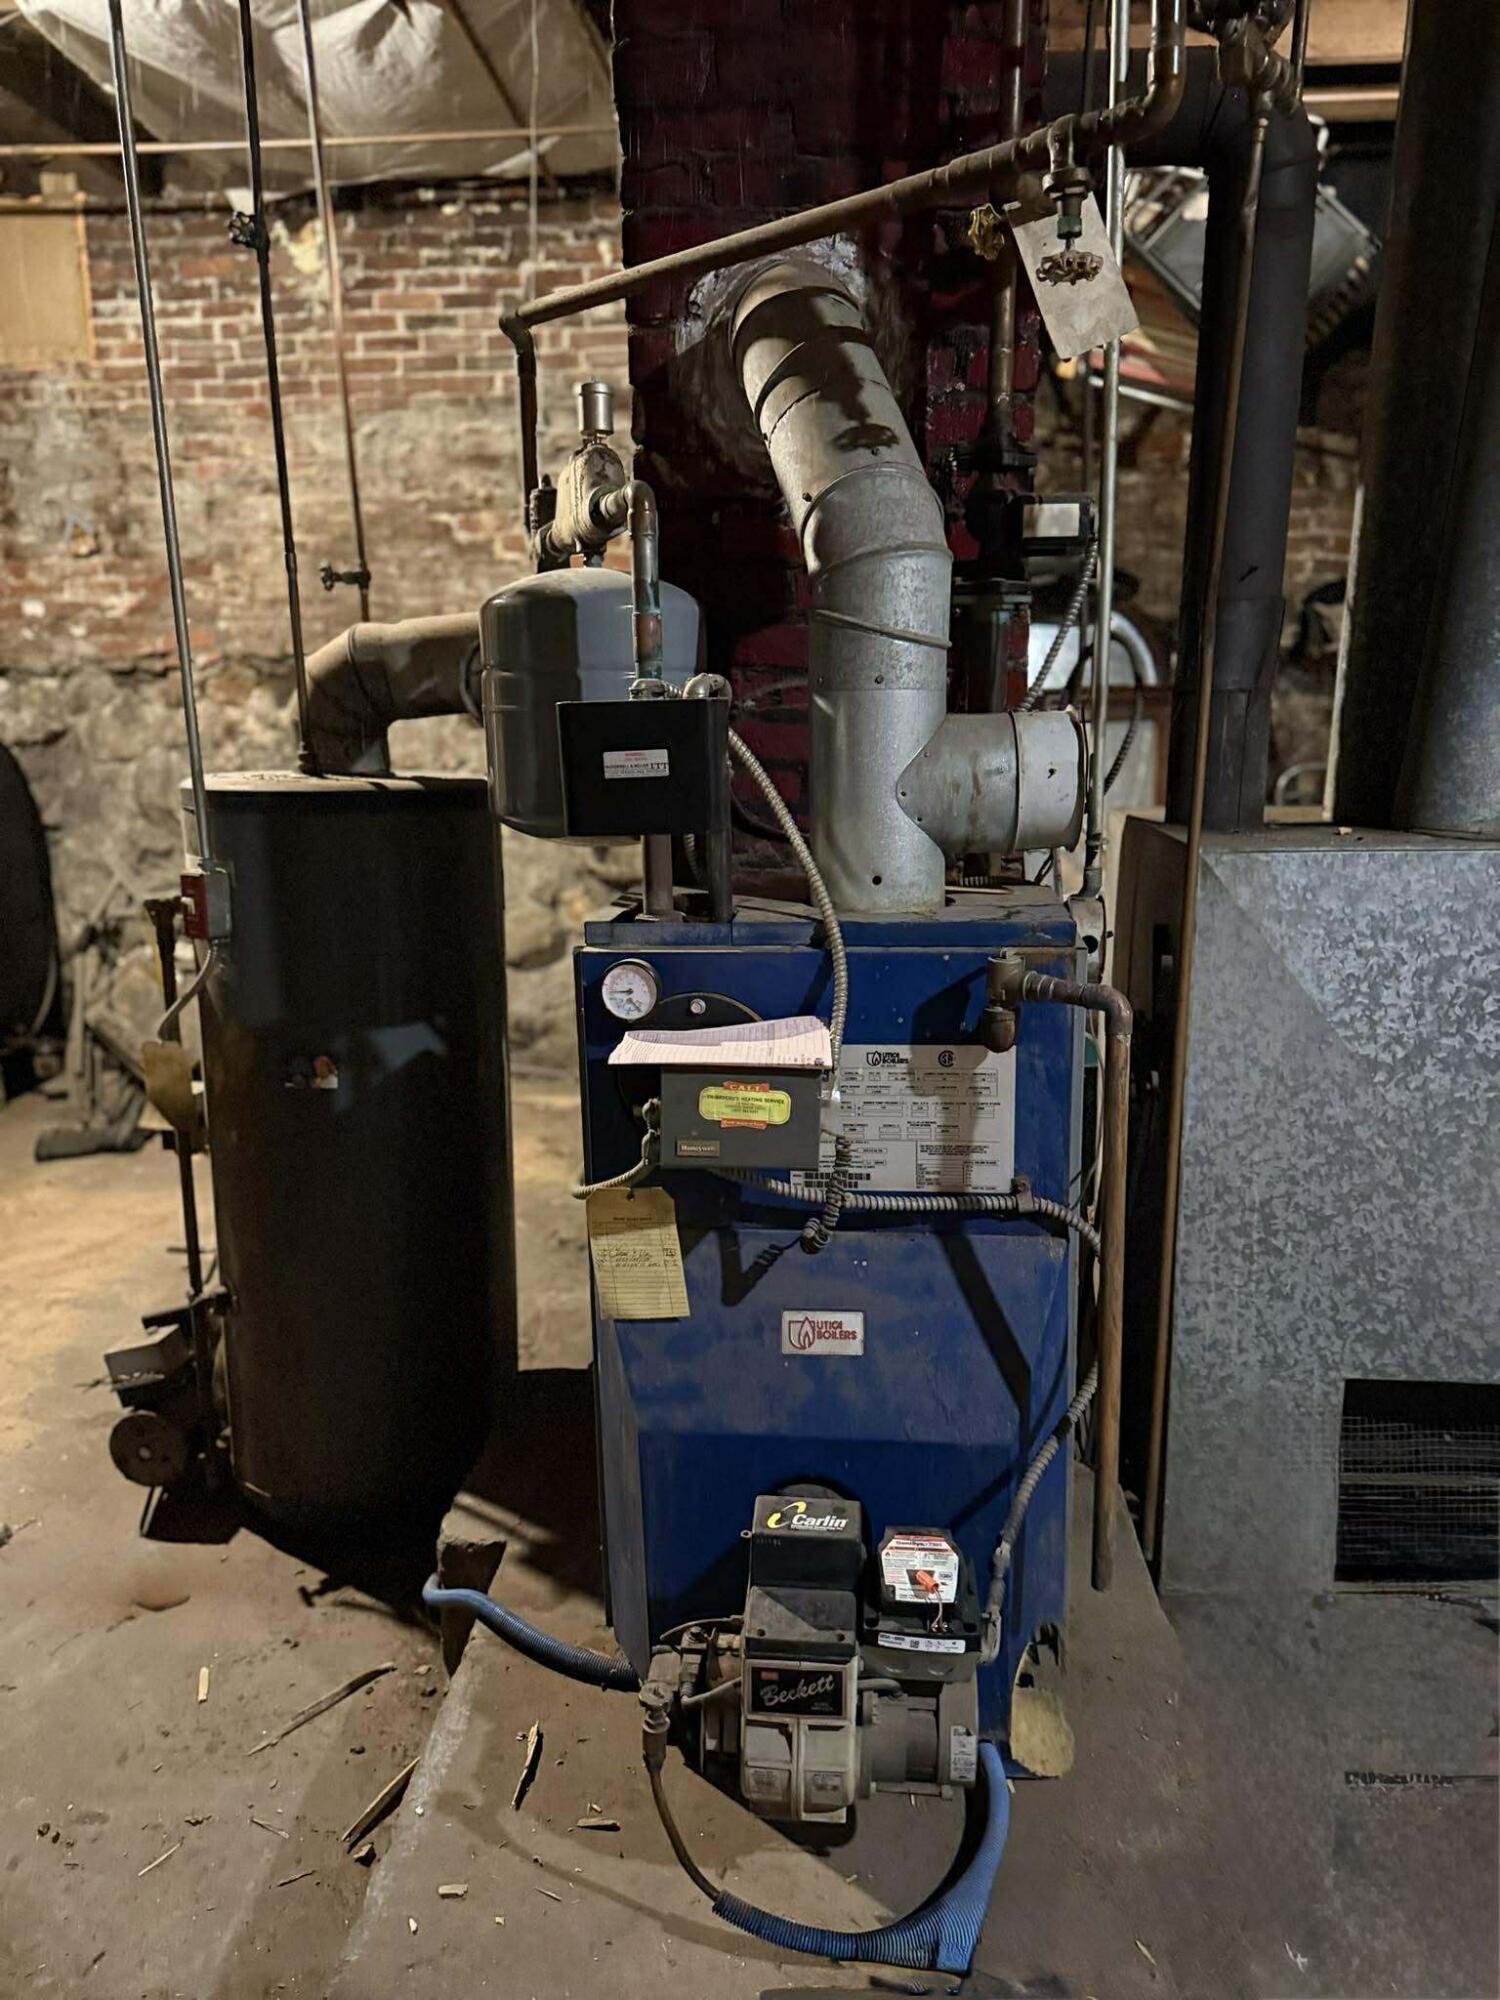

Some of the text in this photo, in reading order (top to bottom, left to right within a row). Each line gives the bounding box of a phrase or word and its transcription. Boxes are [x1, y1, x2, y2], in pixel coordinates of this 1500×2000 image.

[816, 1320, 843, 1330] UTICA
[816, 1330, 857, 1340] BOILERS
[792, 1513, 848, 1528] Carlin
[760, 1674, 835, 1707] Beckett
